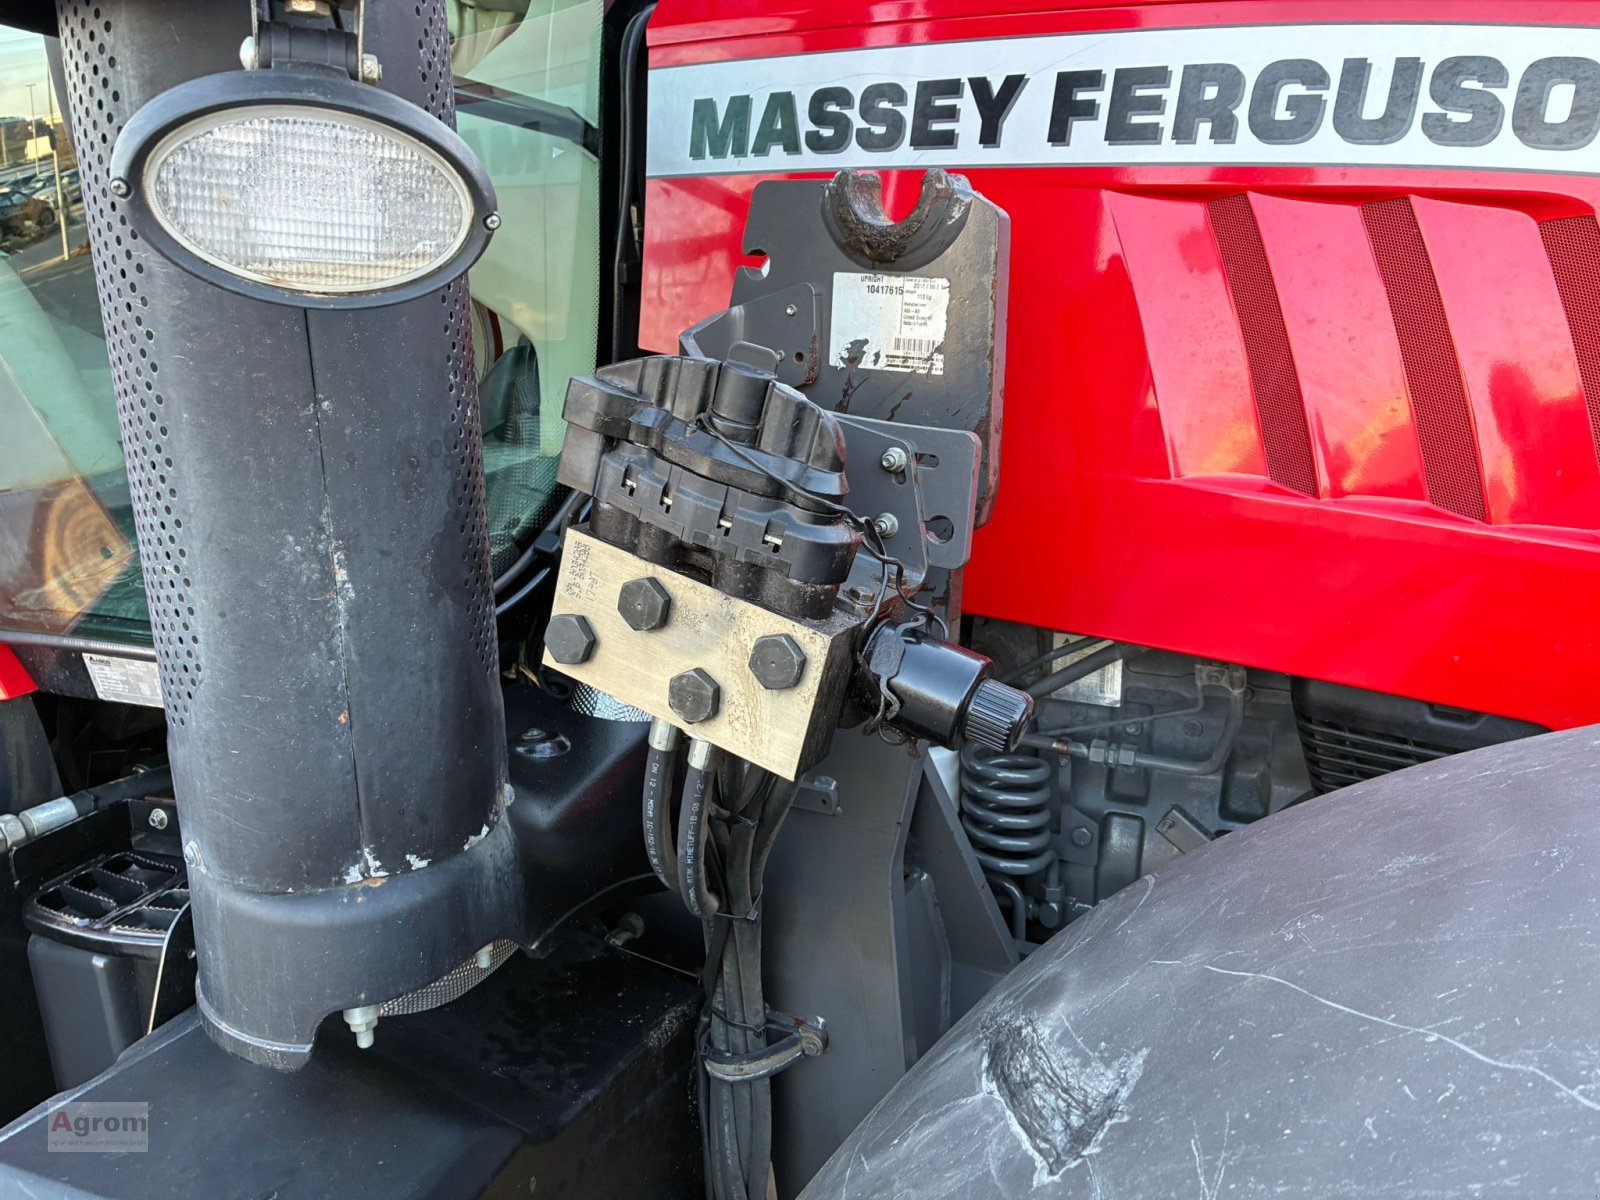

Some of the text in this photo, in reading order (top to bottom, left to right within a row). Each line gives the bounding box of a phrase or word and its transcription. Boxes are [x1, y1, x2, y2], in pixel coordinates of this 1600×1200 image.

[689, 55, 1600, 160] MASSEY FERGUSO
[861, 275, 884, 283] UPRIGHT
[867, 284, 904, 296] 10417615
[651, 762, 659, 774] DN
[649, 778, 657, 788] 12
